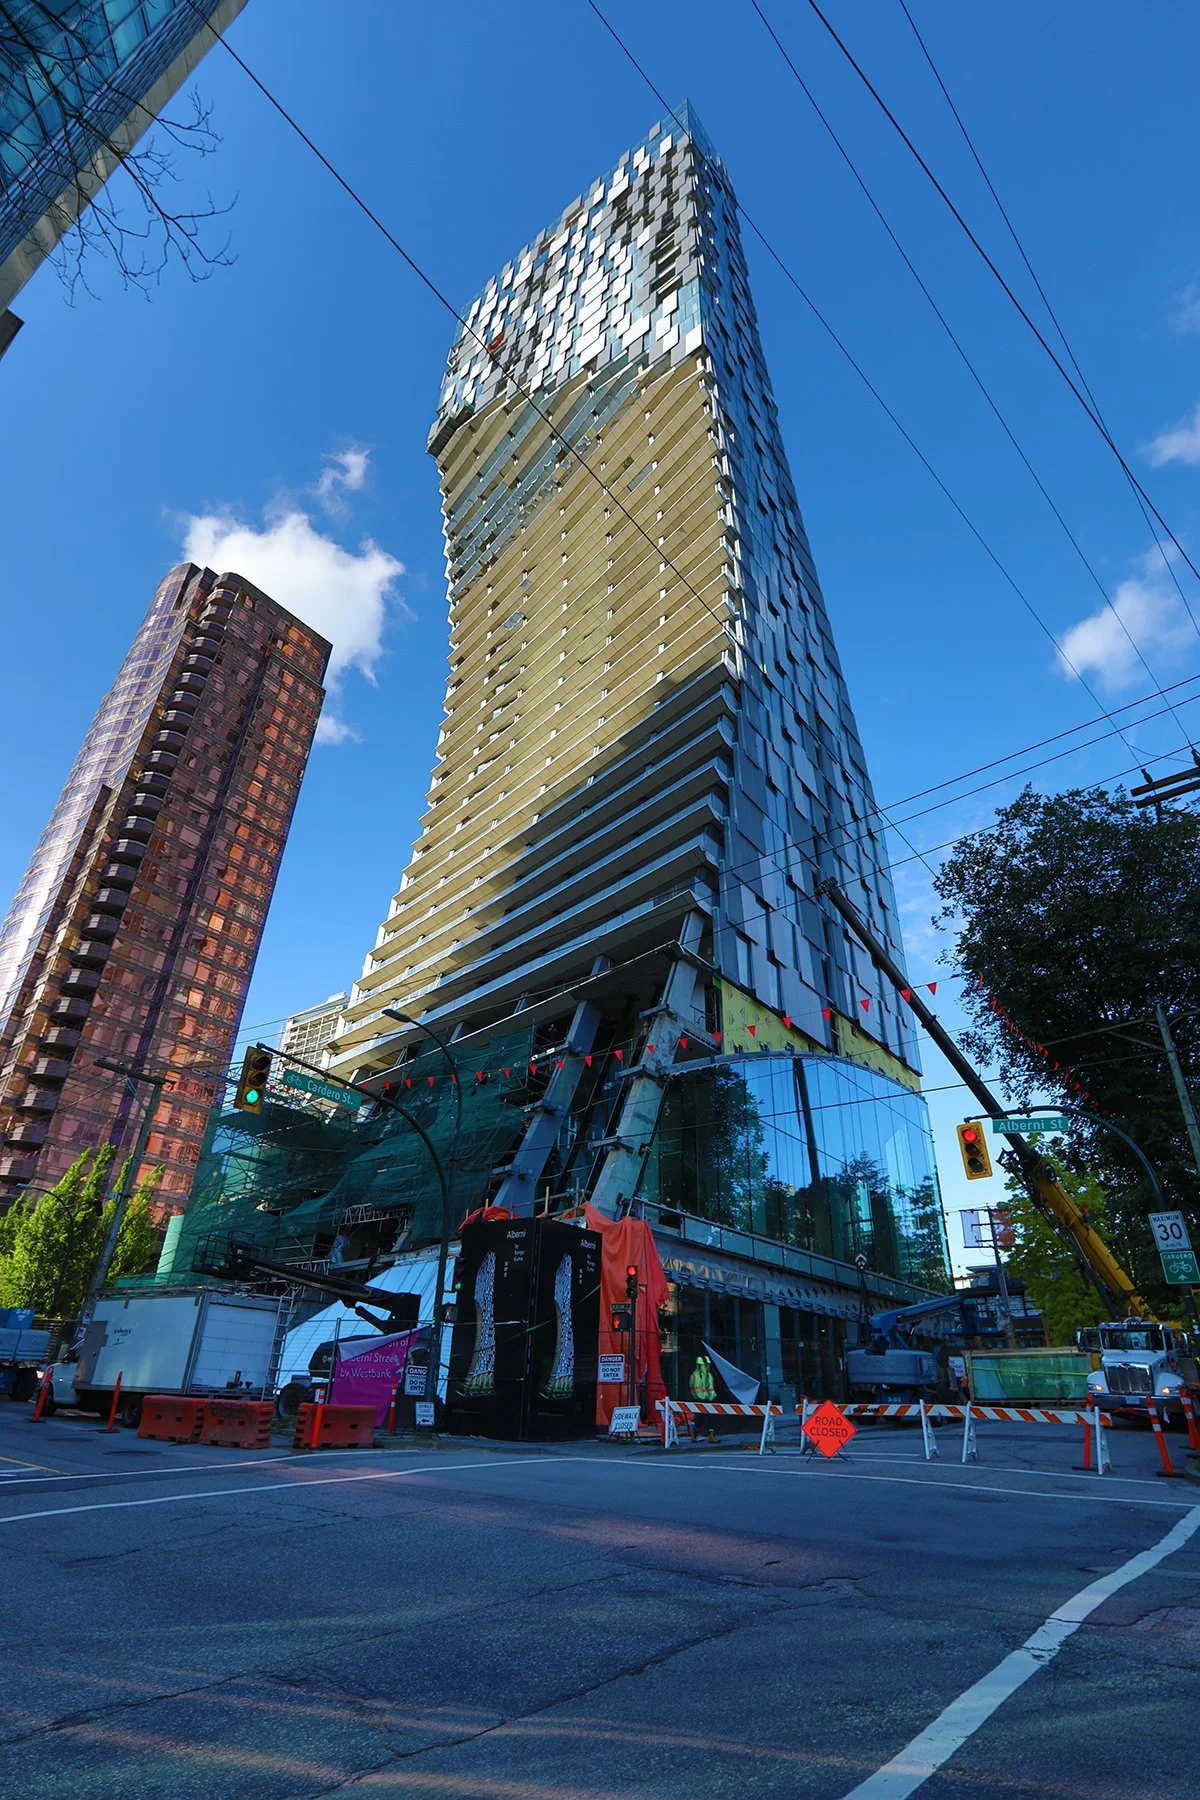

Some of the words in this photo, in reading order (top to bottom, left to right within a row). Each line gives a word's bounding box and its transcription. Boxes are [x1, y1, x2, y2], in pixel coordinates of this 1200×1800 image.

[307, 1080, 340, 1100] Cardero
[342, 1092, 353, 1105] St.
[998, 1120, 1045, 1131] Alberni
[1050, 1119, 1063, 1129] St
[1152, 1214, 1179, 1222] MAXIMUM
[506, 1229, 526, 1239] Alberni
[1157, 1222, 1183, 1241] 30
[373, 1353, 394, 1363] Stree
[351, 1367, 391, 1379] Westbank
[614, 1412, 638, 1420] SIDEWALK
[814, 1416, 843, 1427] ROAD
[615, 1421, 633, 1430] CLOSED
[809, 1426, 849, 1438] CLOSED
